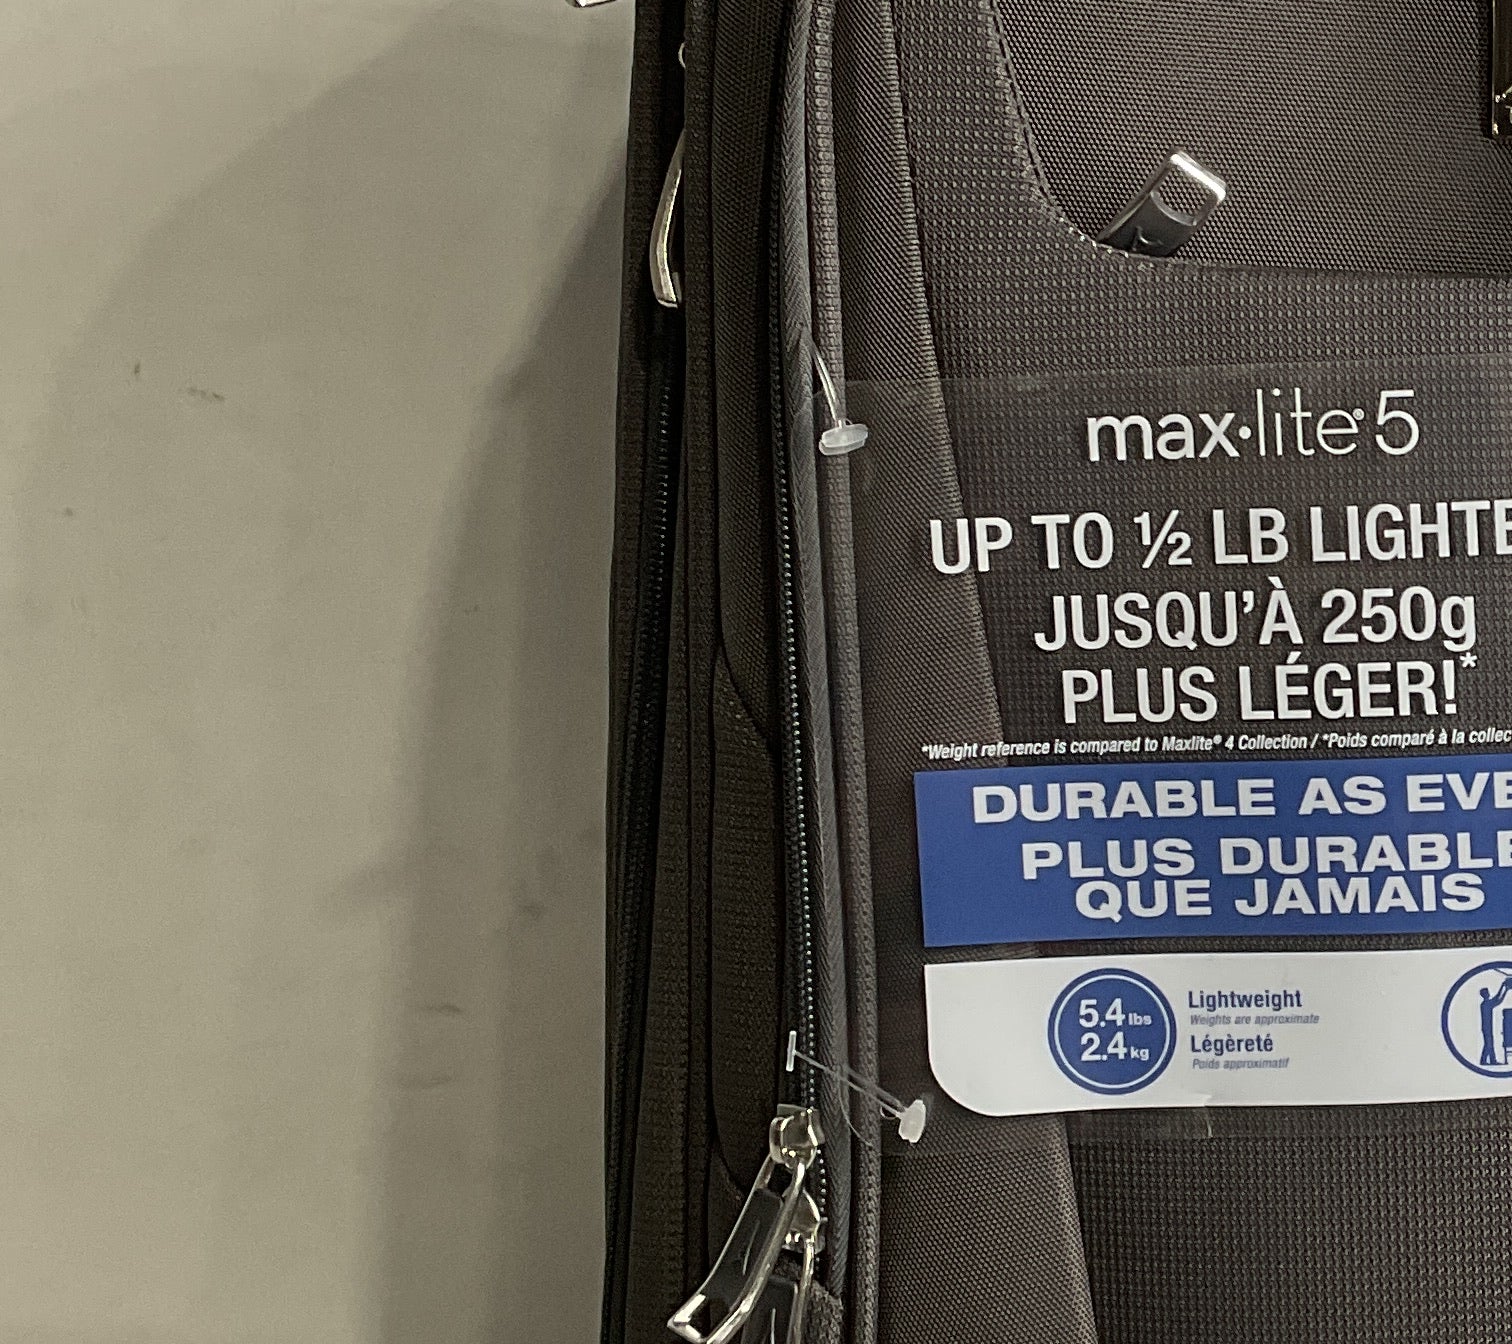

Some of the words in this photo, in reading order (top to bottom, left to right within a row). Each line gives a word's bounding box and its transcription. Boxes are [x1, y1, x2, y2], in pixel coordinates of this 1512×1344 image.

[1377, 388, 1420, 455] 5
[929, 515, 1013, 575] UP
[1031, 510, 1114, 570] TO
[1212, 506, 1289, 565] LB
[1321, 585, 1479, 652] 250g
[1061, 665, 1218, 725] PLUS
[981, 741, 1050, 757] reference
[1054, 738, 1067, 755] is
[1070, 737, 1141, 756] compared
[1144, 737, 1159, 753] to
[1238, 733, 1307, 751] Collection
[1370, 729, 1434, 749] comparé
[1438, 728, 1448, 744] à
[1451, 728, 1467, 744] la
[972, 778, 1276, 824] DURABLE
[1298, 775, 1387, 816] AS
[1021, 838, 1196, 881] PLUS
[1075, 879, 1213, 923] QUE
[1234, 871, 1486, 916] JAMAIS
[1078, 997, 1126, 1029] 5.4
[1128, 1011, 1152, 1026] lbs
[1187, 989, 1304, 1012] Lightweight
[1190, 1013, 1232, 1027] Weights
[1234, 1015, 1252, 1025] are
[1254, 1012, 1320, 1027] approximate
[1080, 1031, 1128, 1063] 2.4
[1130, 1046, 1150, 1062] kg
[1190, 1033, 1274, 1057] Légèreté
[1192, 1058, 1221, 1070] Poids
[1223, 1057, 1291, 1070] approximatif
